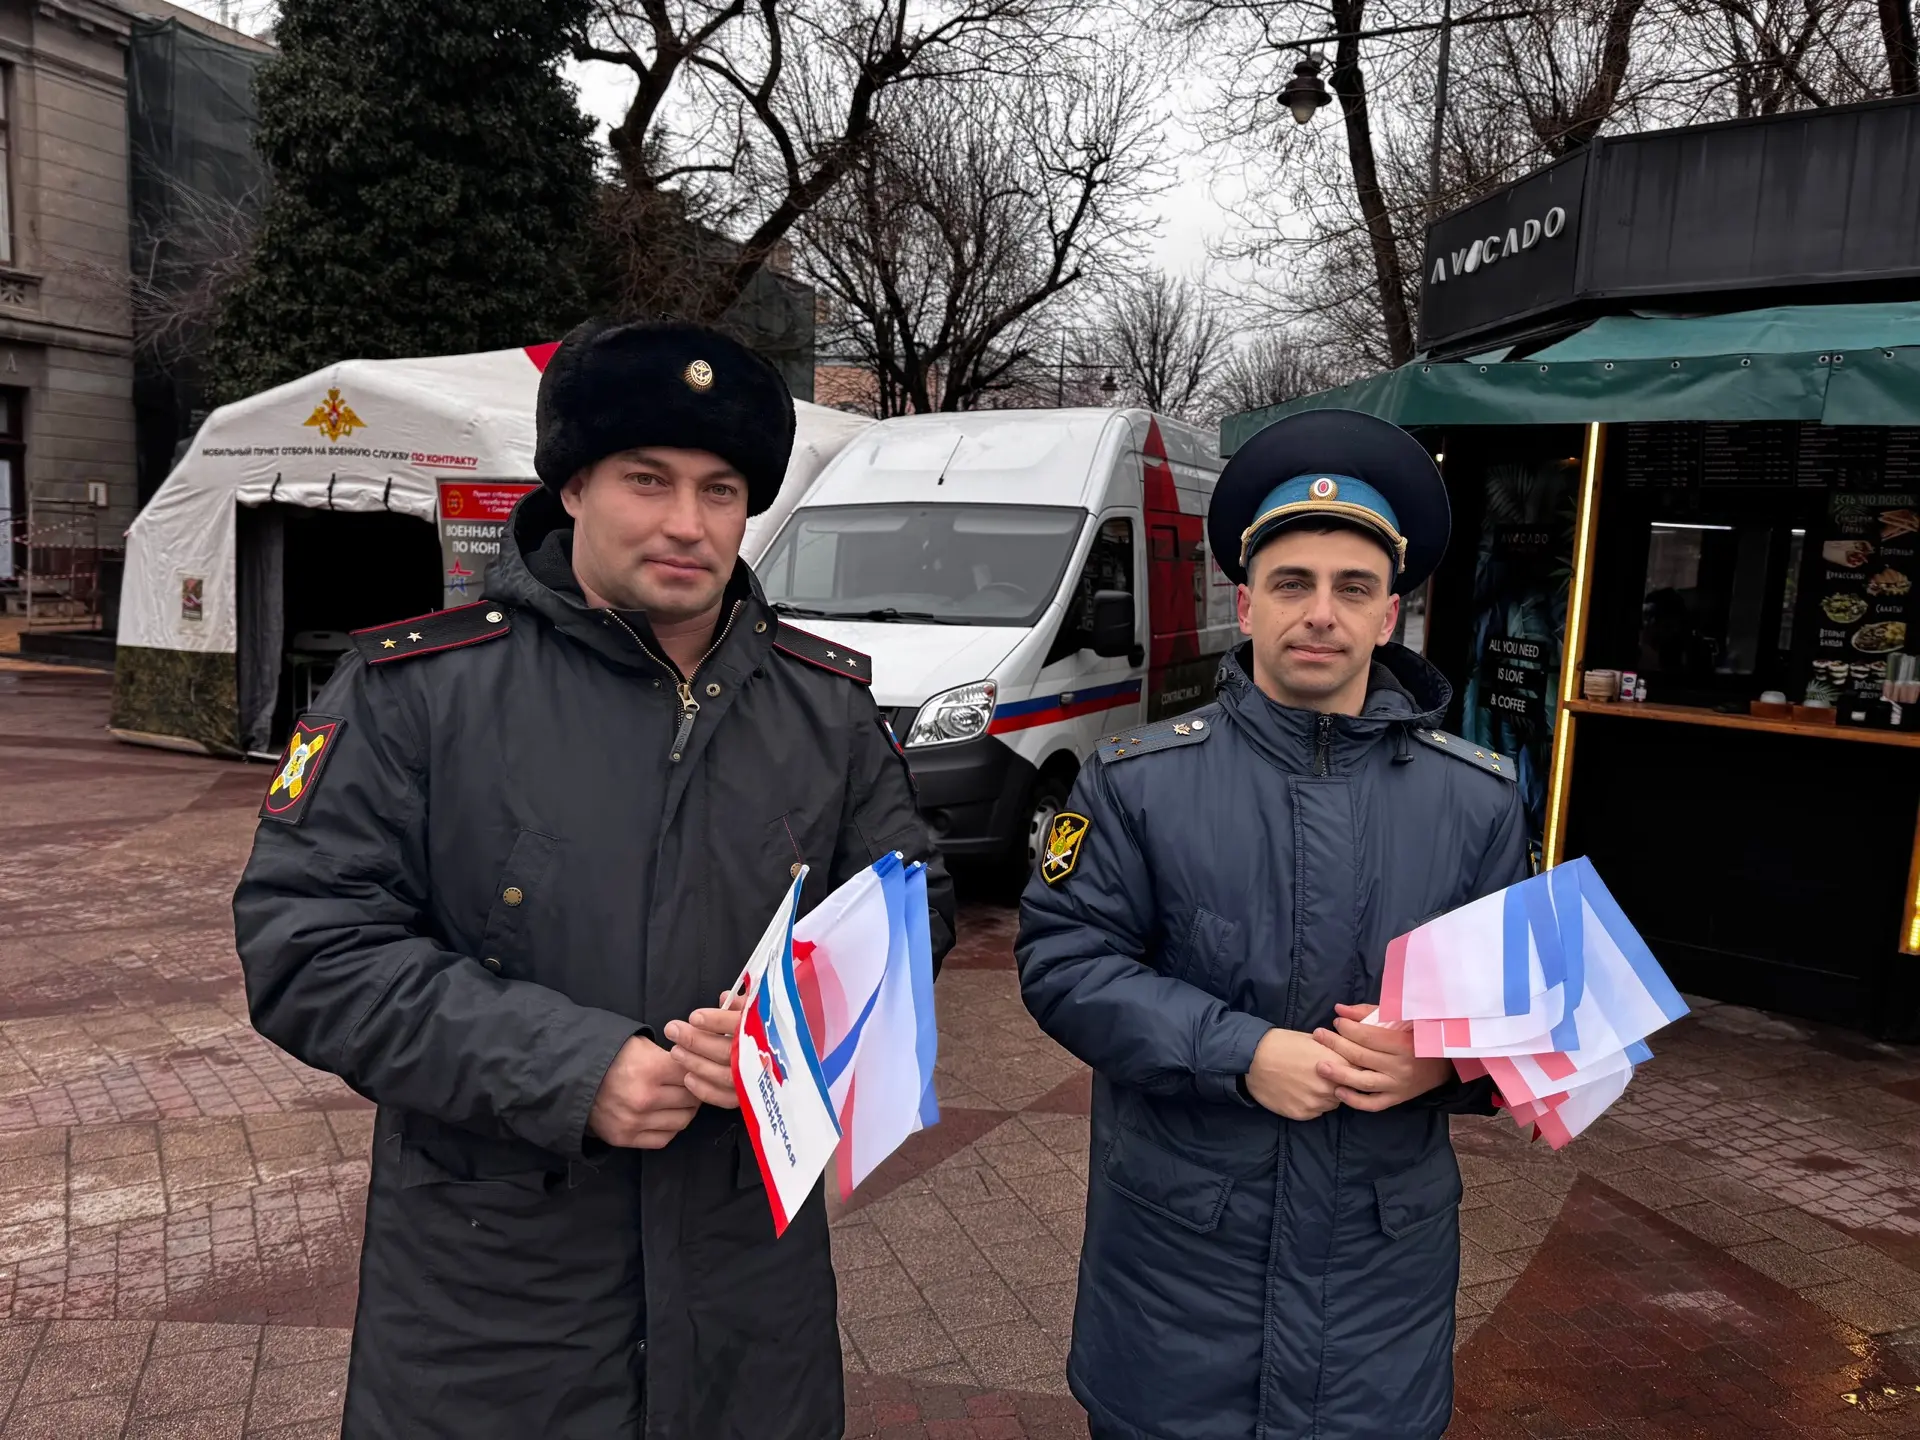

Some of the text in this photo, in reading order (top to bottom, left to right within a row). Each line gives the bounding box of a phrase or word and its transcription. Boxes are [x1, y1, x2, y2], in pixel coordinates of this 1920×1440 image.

[202, 446, 478, 466] МОБИЛЬНЫЙ ПУНКТ ОТБОРА НА ВОЕННУЮ СЛУЖБУ ПО КОНТРАКТУ
[1834, 494, 1856, 505] ЕСТЬ
[1858, 494, 1876, 505] ЧТО
[445, 525, 496, 538] ВОЕННАЯ
[452, 540, 468, 552] ПО
[1488, 638, 1540, 659] ALL YOU NEED
[1497, 666, 1524, 684] IS LOVE
[1490, 692, 1527, 713] & COFFEE
[758, 1079, 778, 1136] ВЕСНА
[763, 1070, 796, 1168] КРЫМСКАЯ
